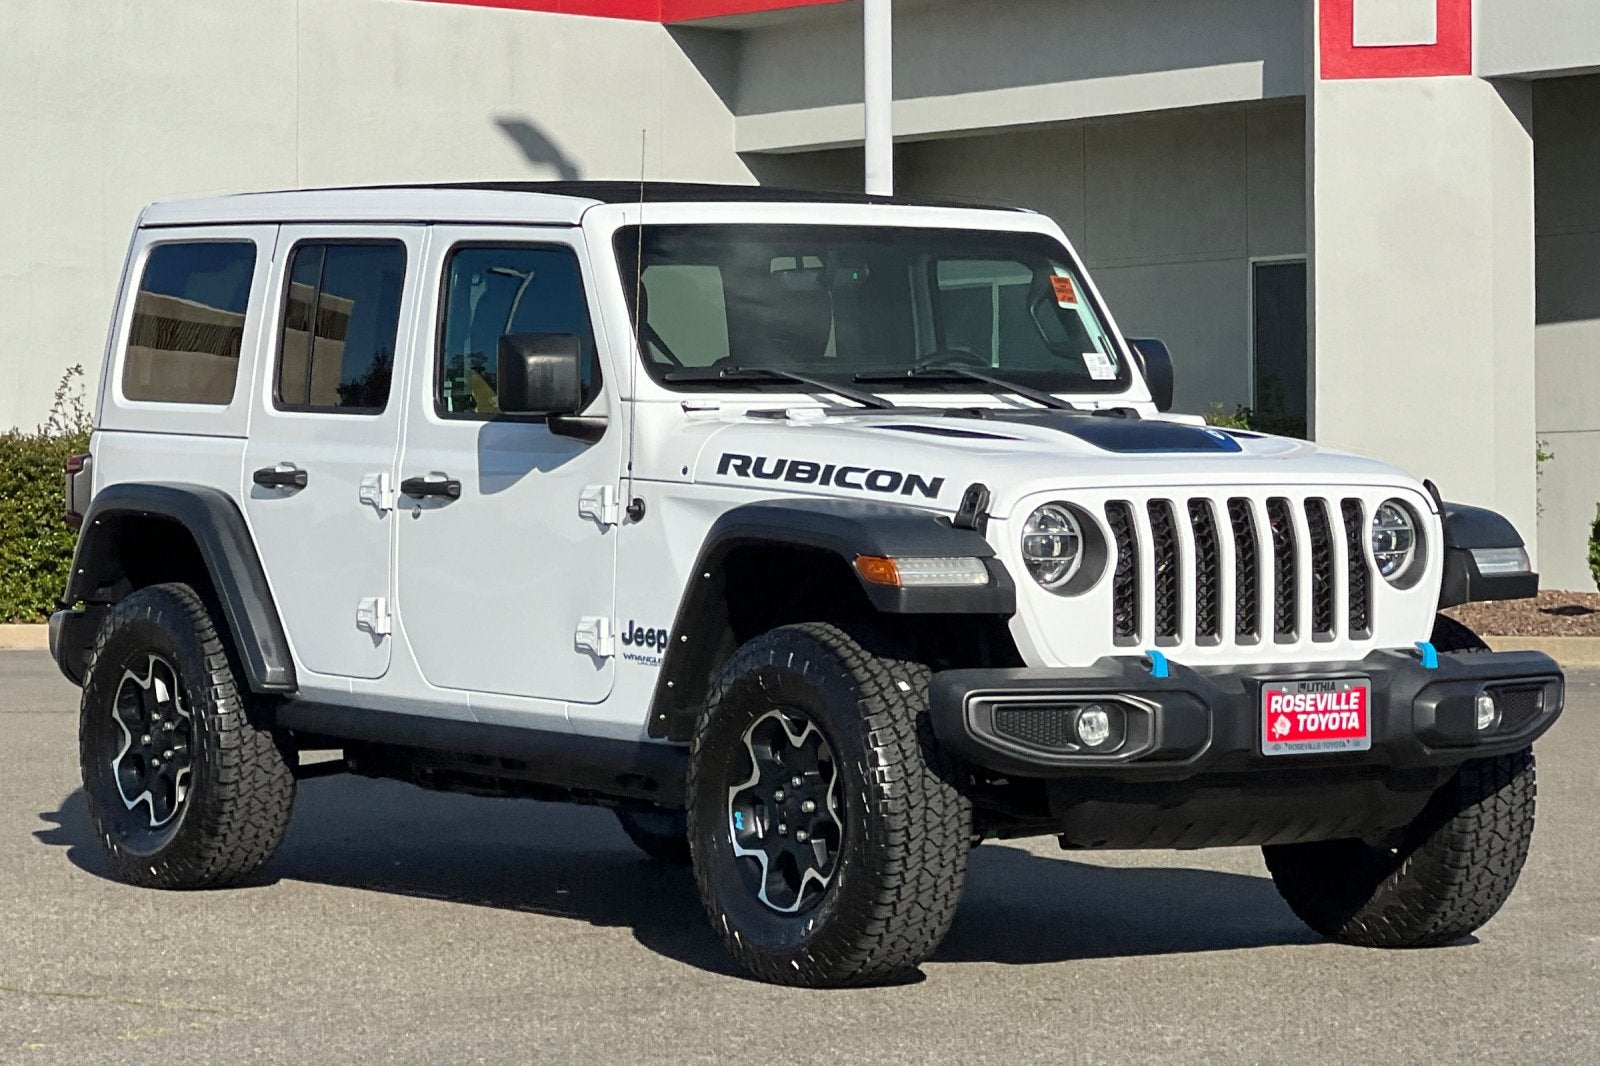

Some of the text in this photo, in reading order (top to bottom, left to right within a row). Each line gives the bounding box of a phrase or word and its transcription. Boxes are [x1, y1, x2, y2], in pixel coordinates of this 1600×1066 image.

[716, 452, 945, 499] RUBICON
[621, 619, 668, 654] Jeep
[623, 652, 663, 664] WRANGLE
[1306, 681, 1337, 693] LITHIA
[1270, 692, 1361, 714] ROSEVILLE
[1296, 712, 1360, 732] TOYOTA
